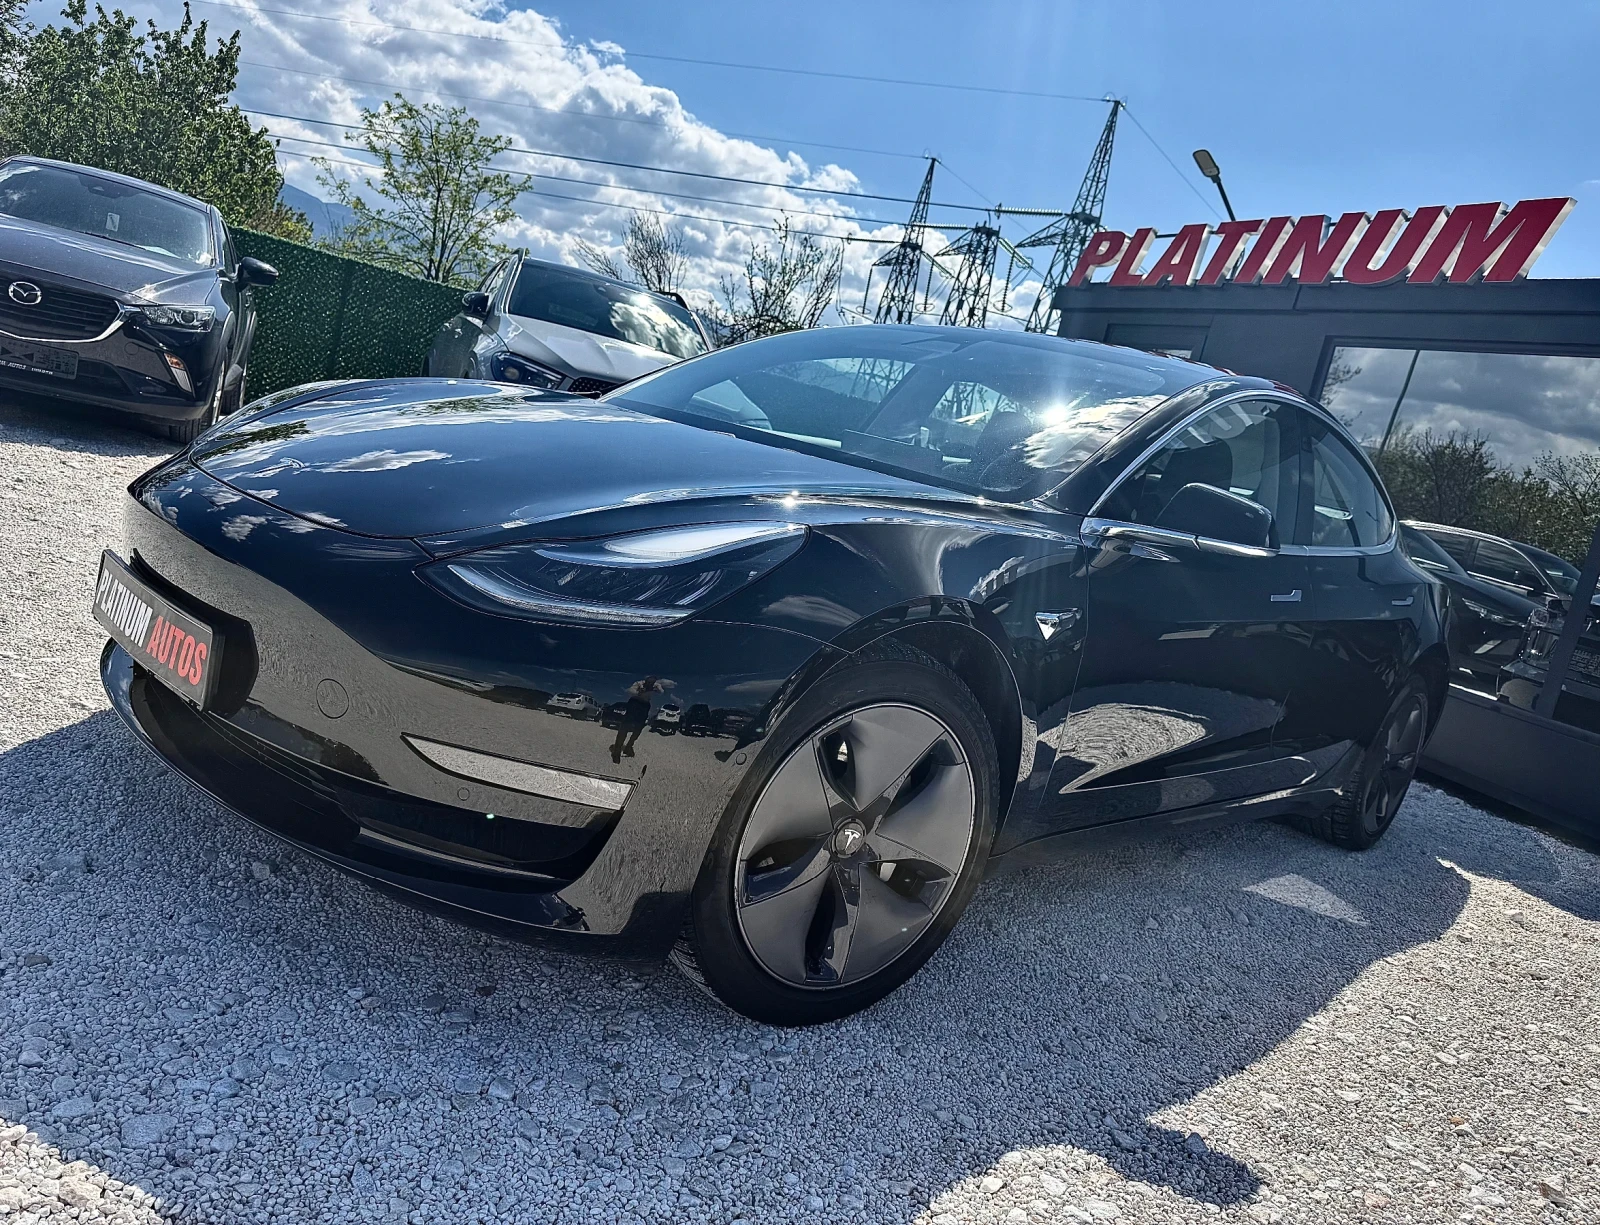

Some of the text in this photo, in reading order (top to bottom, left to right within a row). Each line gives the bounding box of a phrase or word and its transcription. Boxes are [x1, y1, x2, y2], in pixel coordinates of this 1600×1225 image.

[1065, 196, 1577, 288] PLATINUM
[95, 567, 207, 686] PLATINUM AUTOS
